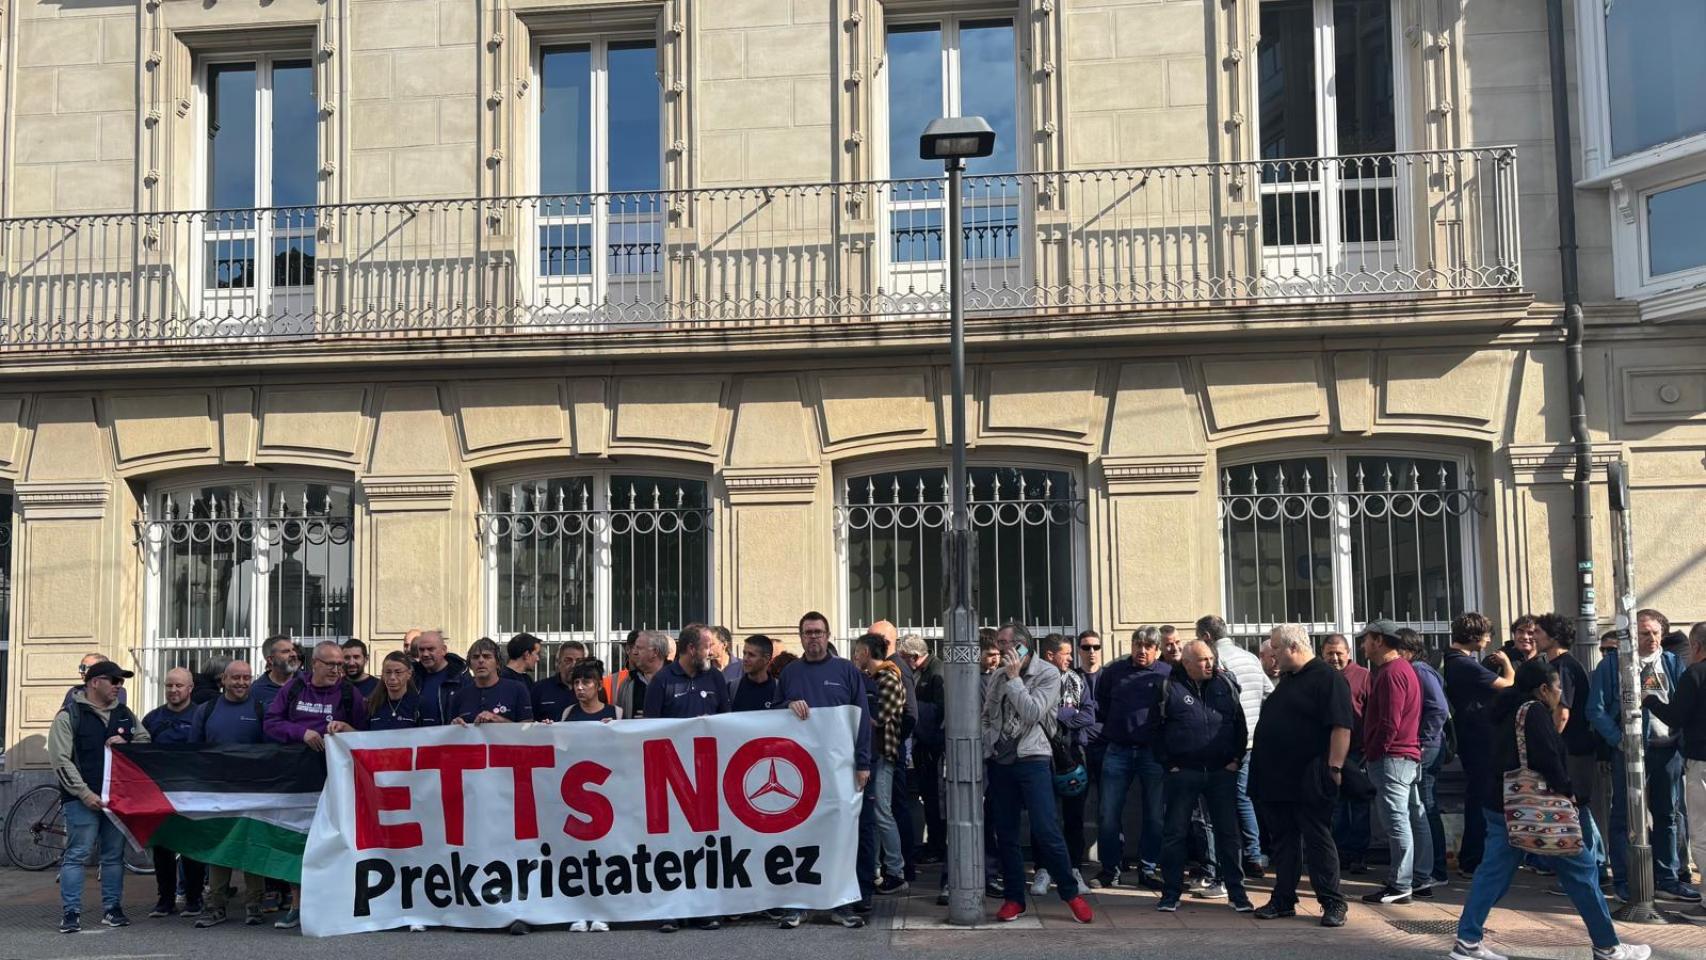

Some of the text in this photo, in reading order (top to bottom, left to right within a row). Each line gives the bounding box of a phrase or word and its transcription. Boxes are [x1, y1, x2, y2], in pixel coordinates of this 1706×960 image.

[352, 737, 820, 849] ETTs NO
[354, 835, 821, 917] Prekarietaterik ez
